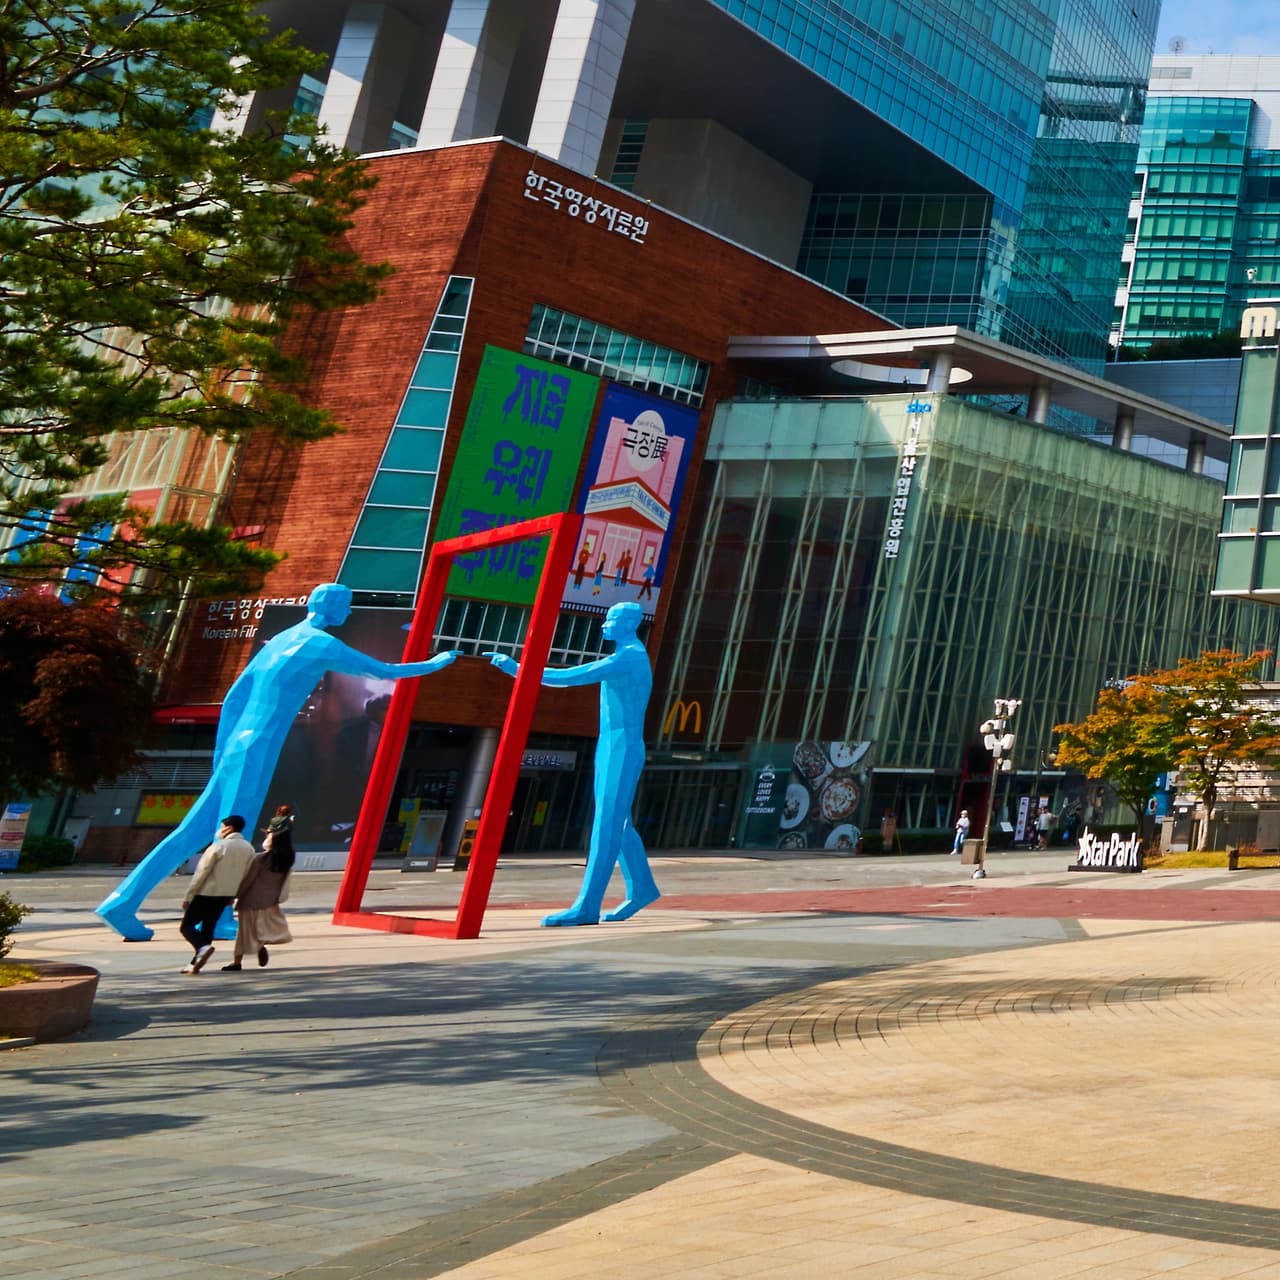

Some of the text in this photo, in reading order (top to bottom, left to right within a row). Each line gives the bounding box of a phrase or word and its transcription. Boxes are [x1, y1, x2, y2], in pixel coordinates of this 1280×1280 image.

[523, 169, 650, 245] 한국영상자료원
[503, 363, 572, 433] 지금
[906, 400, 932, 414] sba
[622, 427, 669, 462] 극장展
[885, 417, 922, 559] 서울산업진흥원
[202, 626, 238, 639] Korean
